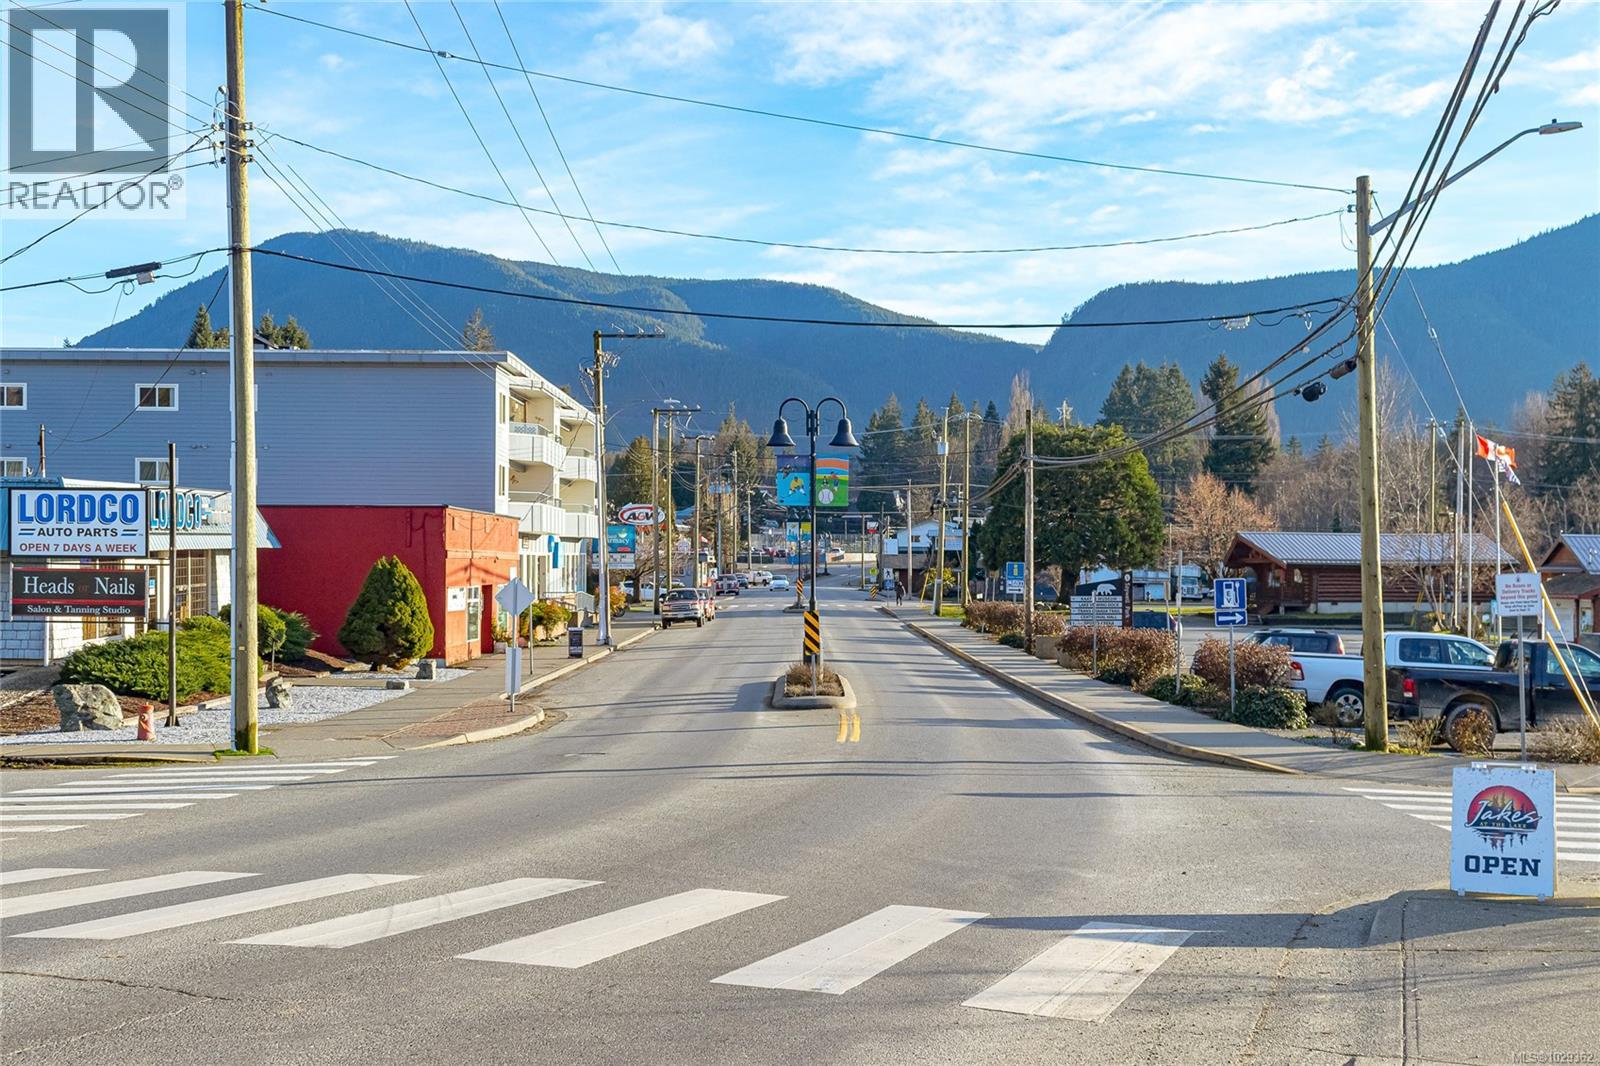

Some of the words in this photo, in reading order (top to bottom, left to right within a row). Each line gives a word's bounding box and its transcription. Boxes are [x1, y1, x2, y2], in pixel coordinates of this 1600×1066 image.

[17, 493, 139, 525] LORDCO
[150, 489, 201, 530] LODCO
[37, 527, 72, 537] AUTO
[77, 527, 118, 537] PARTS
[19, 543, 50, 552] OPEN
[54, 543, 59, 552] 7
[63, 543, 92, 552] DAYS
[95, 544, 102, 552] A
[105, 544, 137, 553] WEEK
[23, 576, 75, 594] Heads
[94, 576, 136, 595] Nails
[27, 604, 52, 613] Salon
[54, 605, 61, 613] &
[64, 605, 100, 615] Tanning
[102, 605, 131, 614] Studio
[1464, 800, 1542, 828] Jakes
[1464, 855, 1541, 877] OPEN
